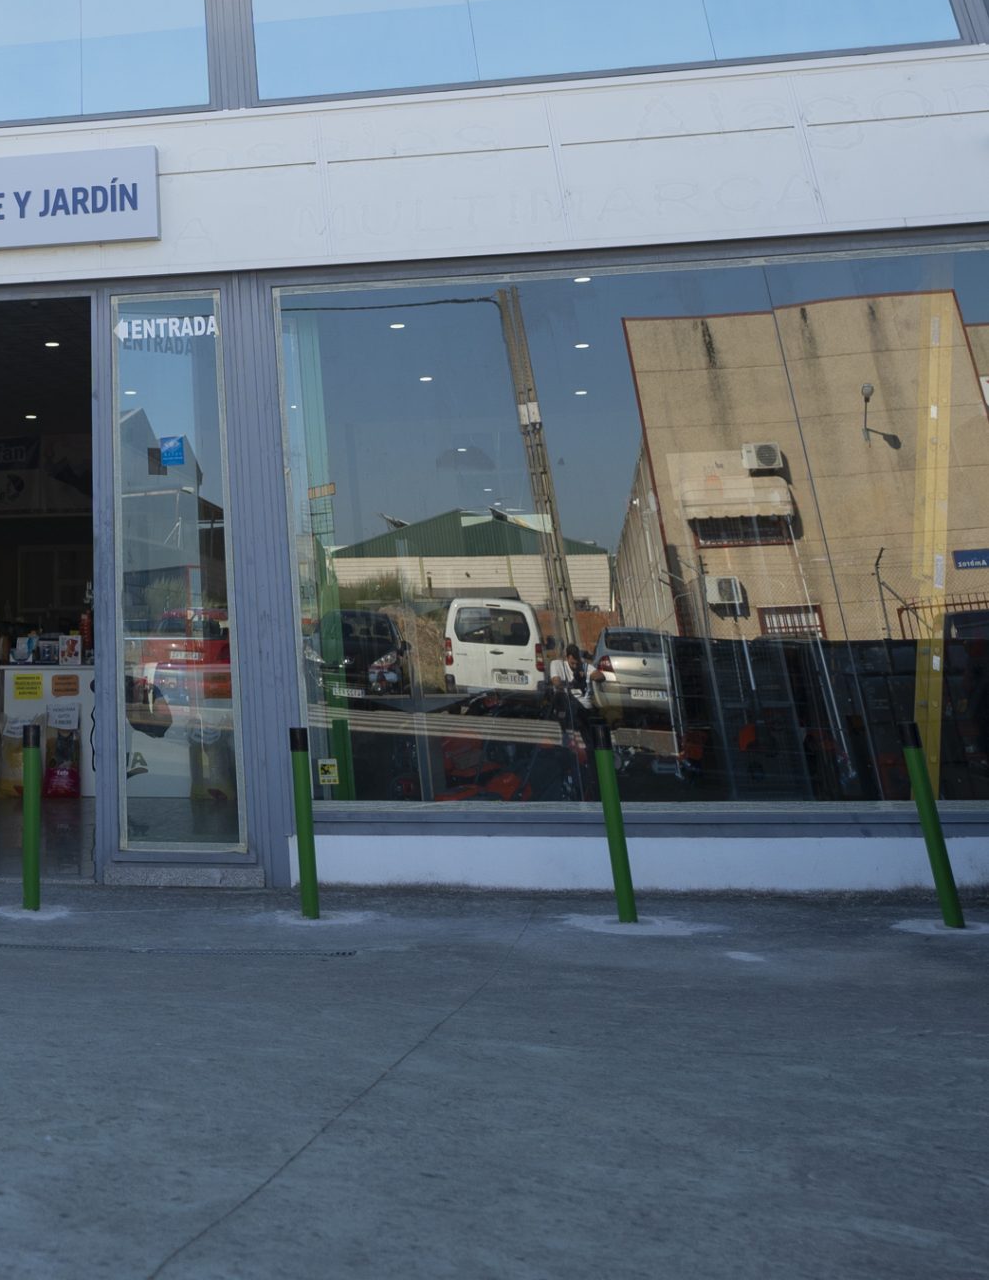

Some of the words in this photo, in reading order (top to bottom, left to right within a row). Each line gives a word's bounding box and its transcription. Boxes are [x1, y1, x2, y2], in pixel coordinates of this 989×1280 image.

[12, 190, 32, 219] Y
[38, 177, 139, 218] JARDÍN
[131, 316, 219, 339] ENTRADA
